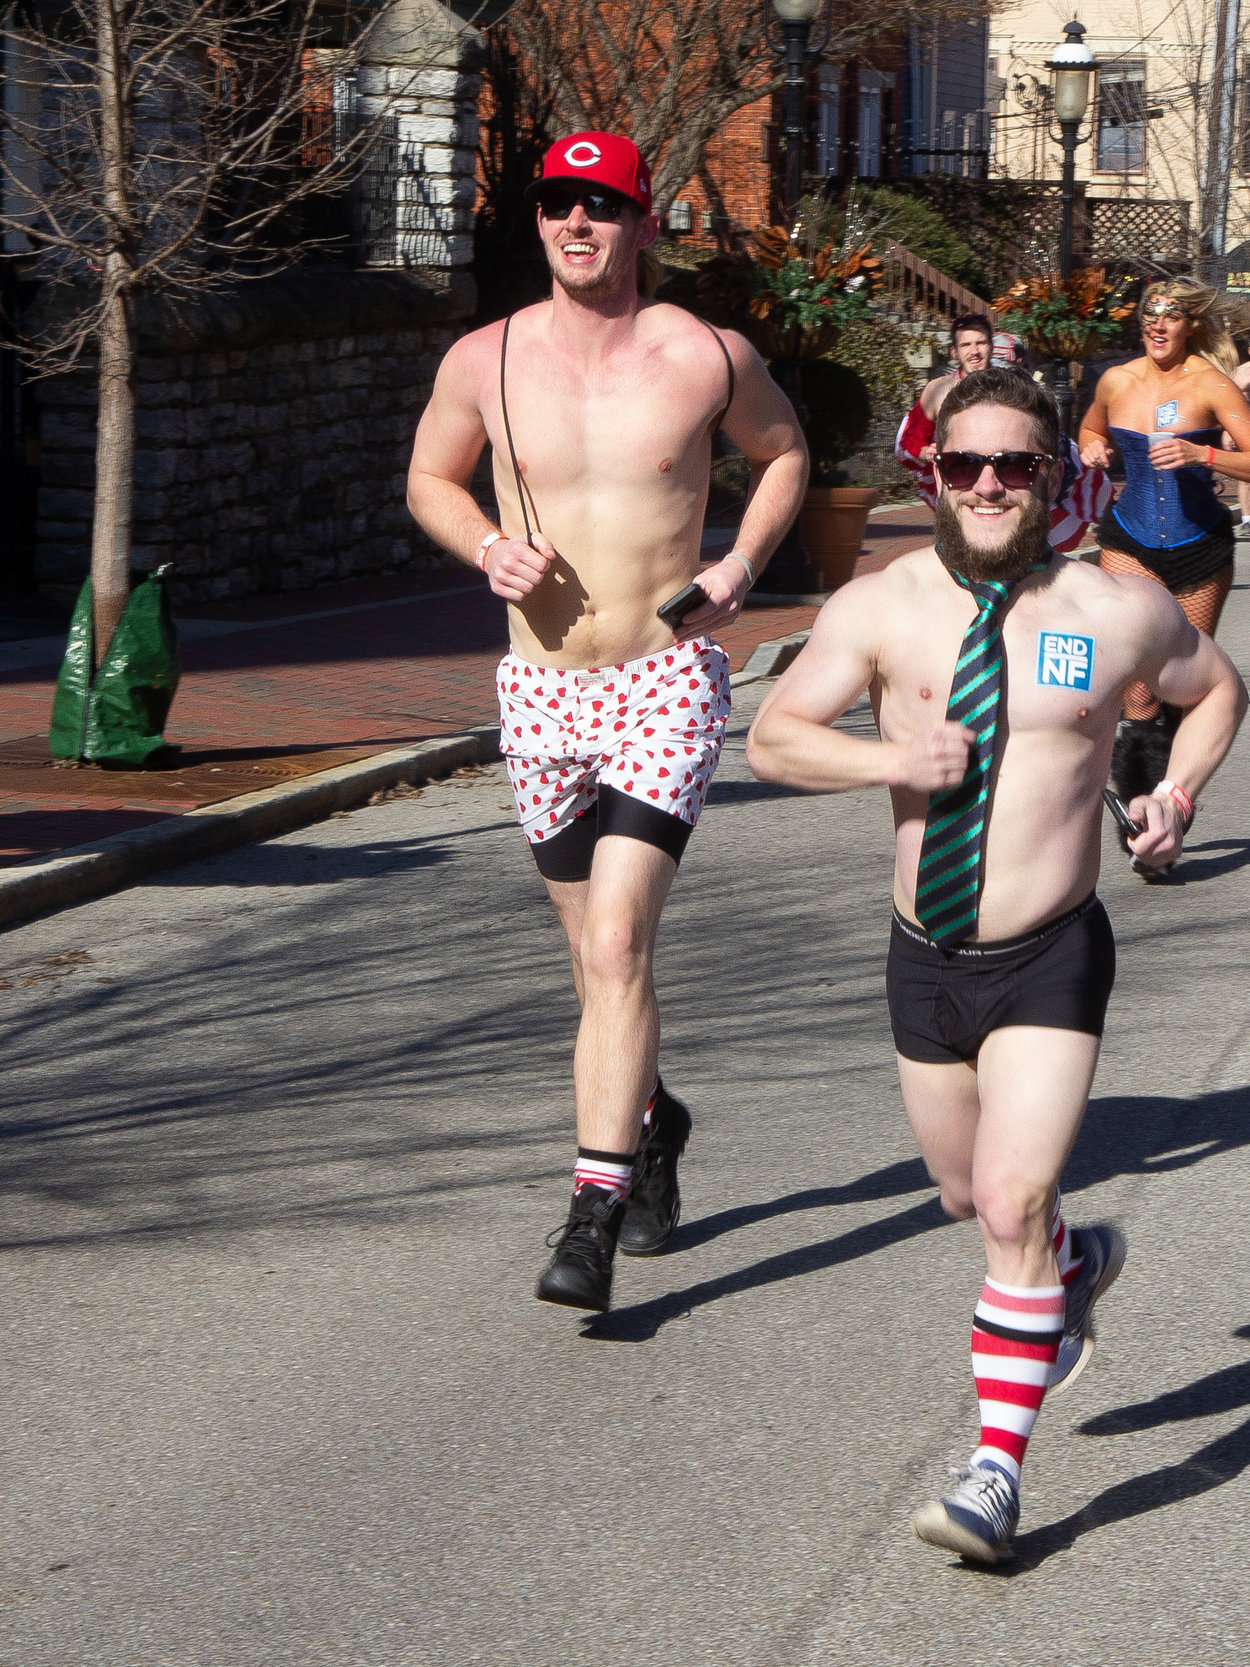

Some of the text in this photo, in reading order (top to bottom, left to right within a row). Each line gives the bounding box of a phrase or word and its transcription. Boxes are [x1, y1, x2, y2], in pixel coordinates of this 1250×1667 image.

[563, 141, 602, 168] C
[1044, 635, 1088, 656] END
[1042, 657, 1088, 686] NF
